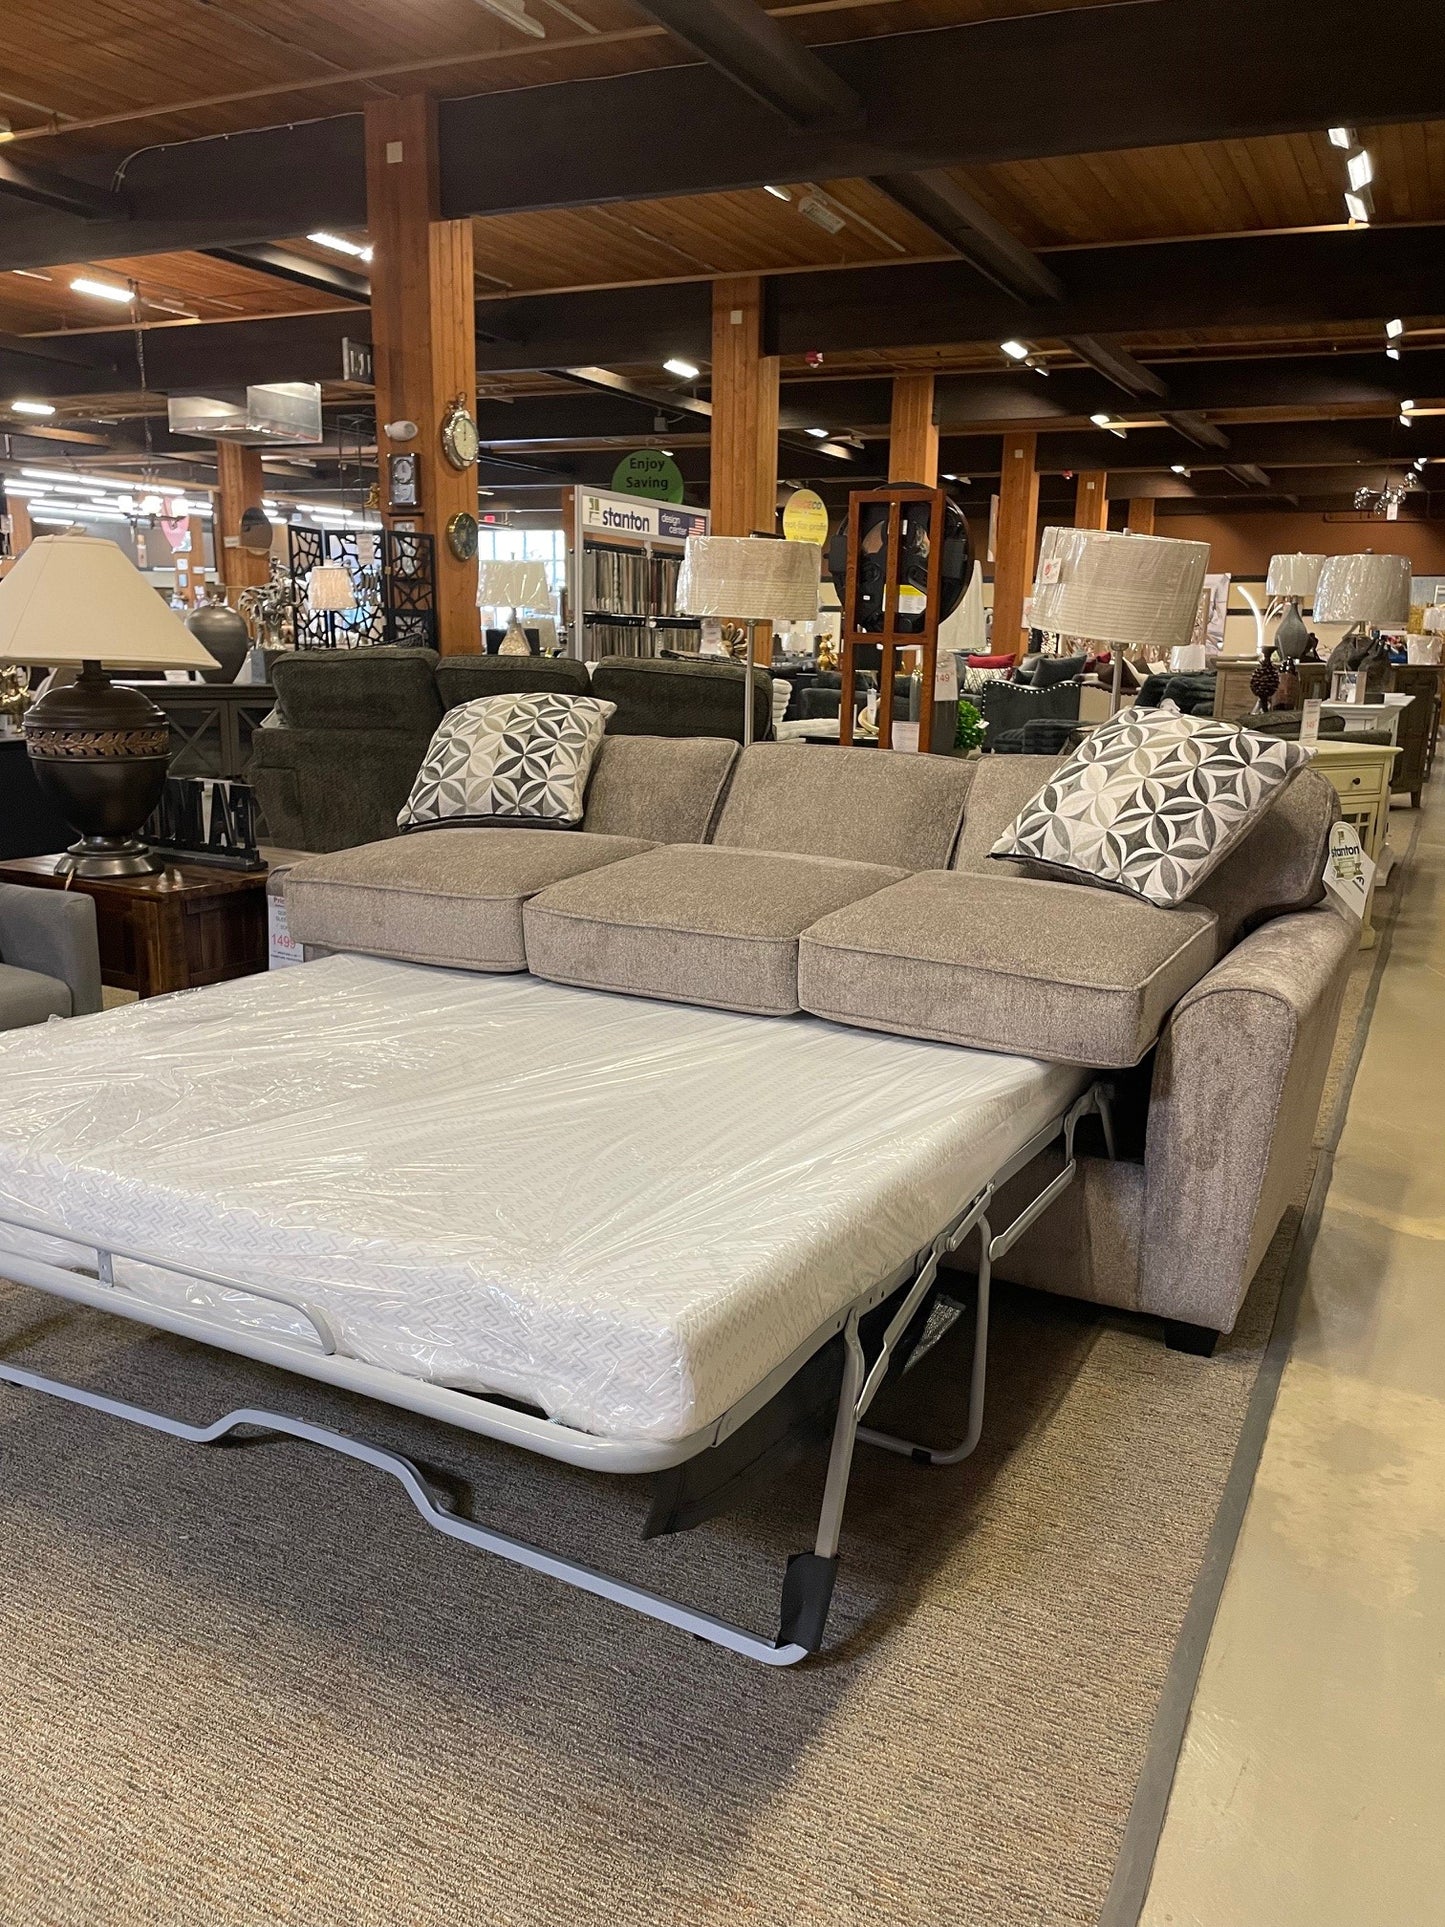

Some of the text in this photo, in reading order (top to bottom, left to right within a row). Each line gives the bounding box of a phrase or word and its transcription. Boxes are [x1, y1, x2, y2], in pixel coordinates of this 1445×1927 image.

[629, 458, 665, 472] Enjoy
[626, 476, 668, 490] Saving
[602, 507, 650, 532] stanton
[660, 513, 681, 526] design
[668, 526, 688, 535] center
[1331, 845, 1360, 858] stanton
[271, 933, 296, 949] 1499
